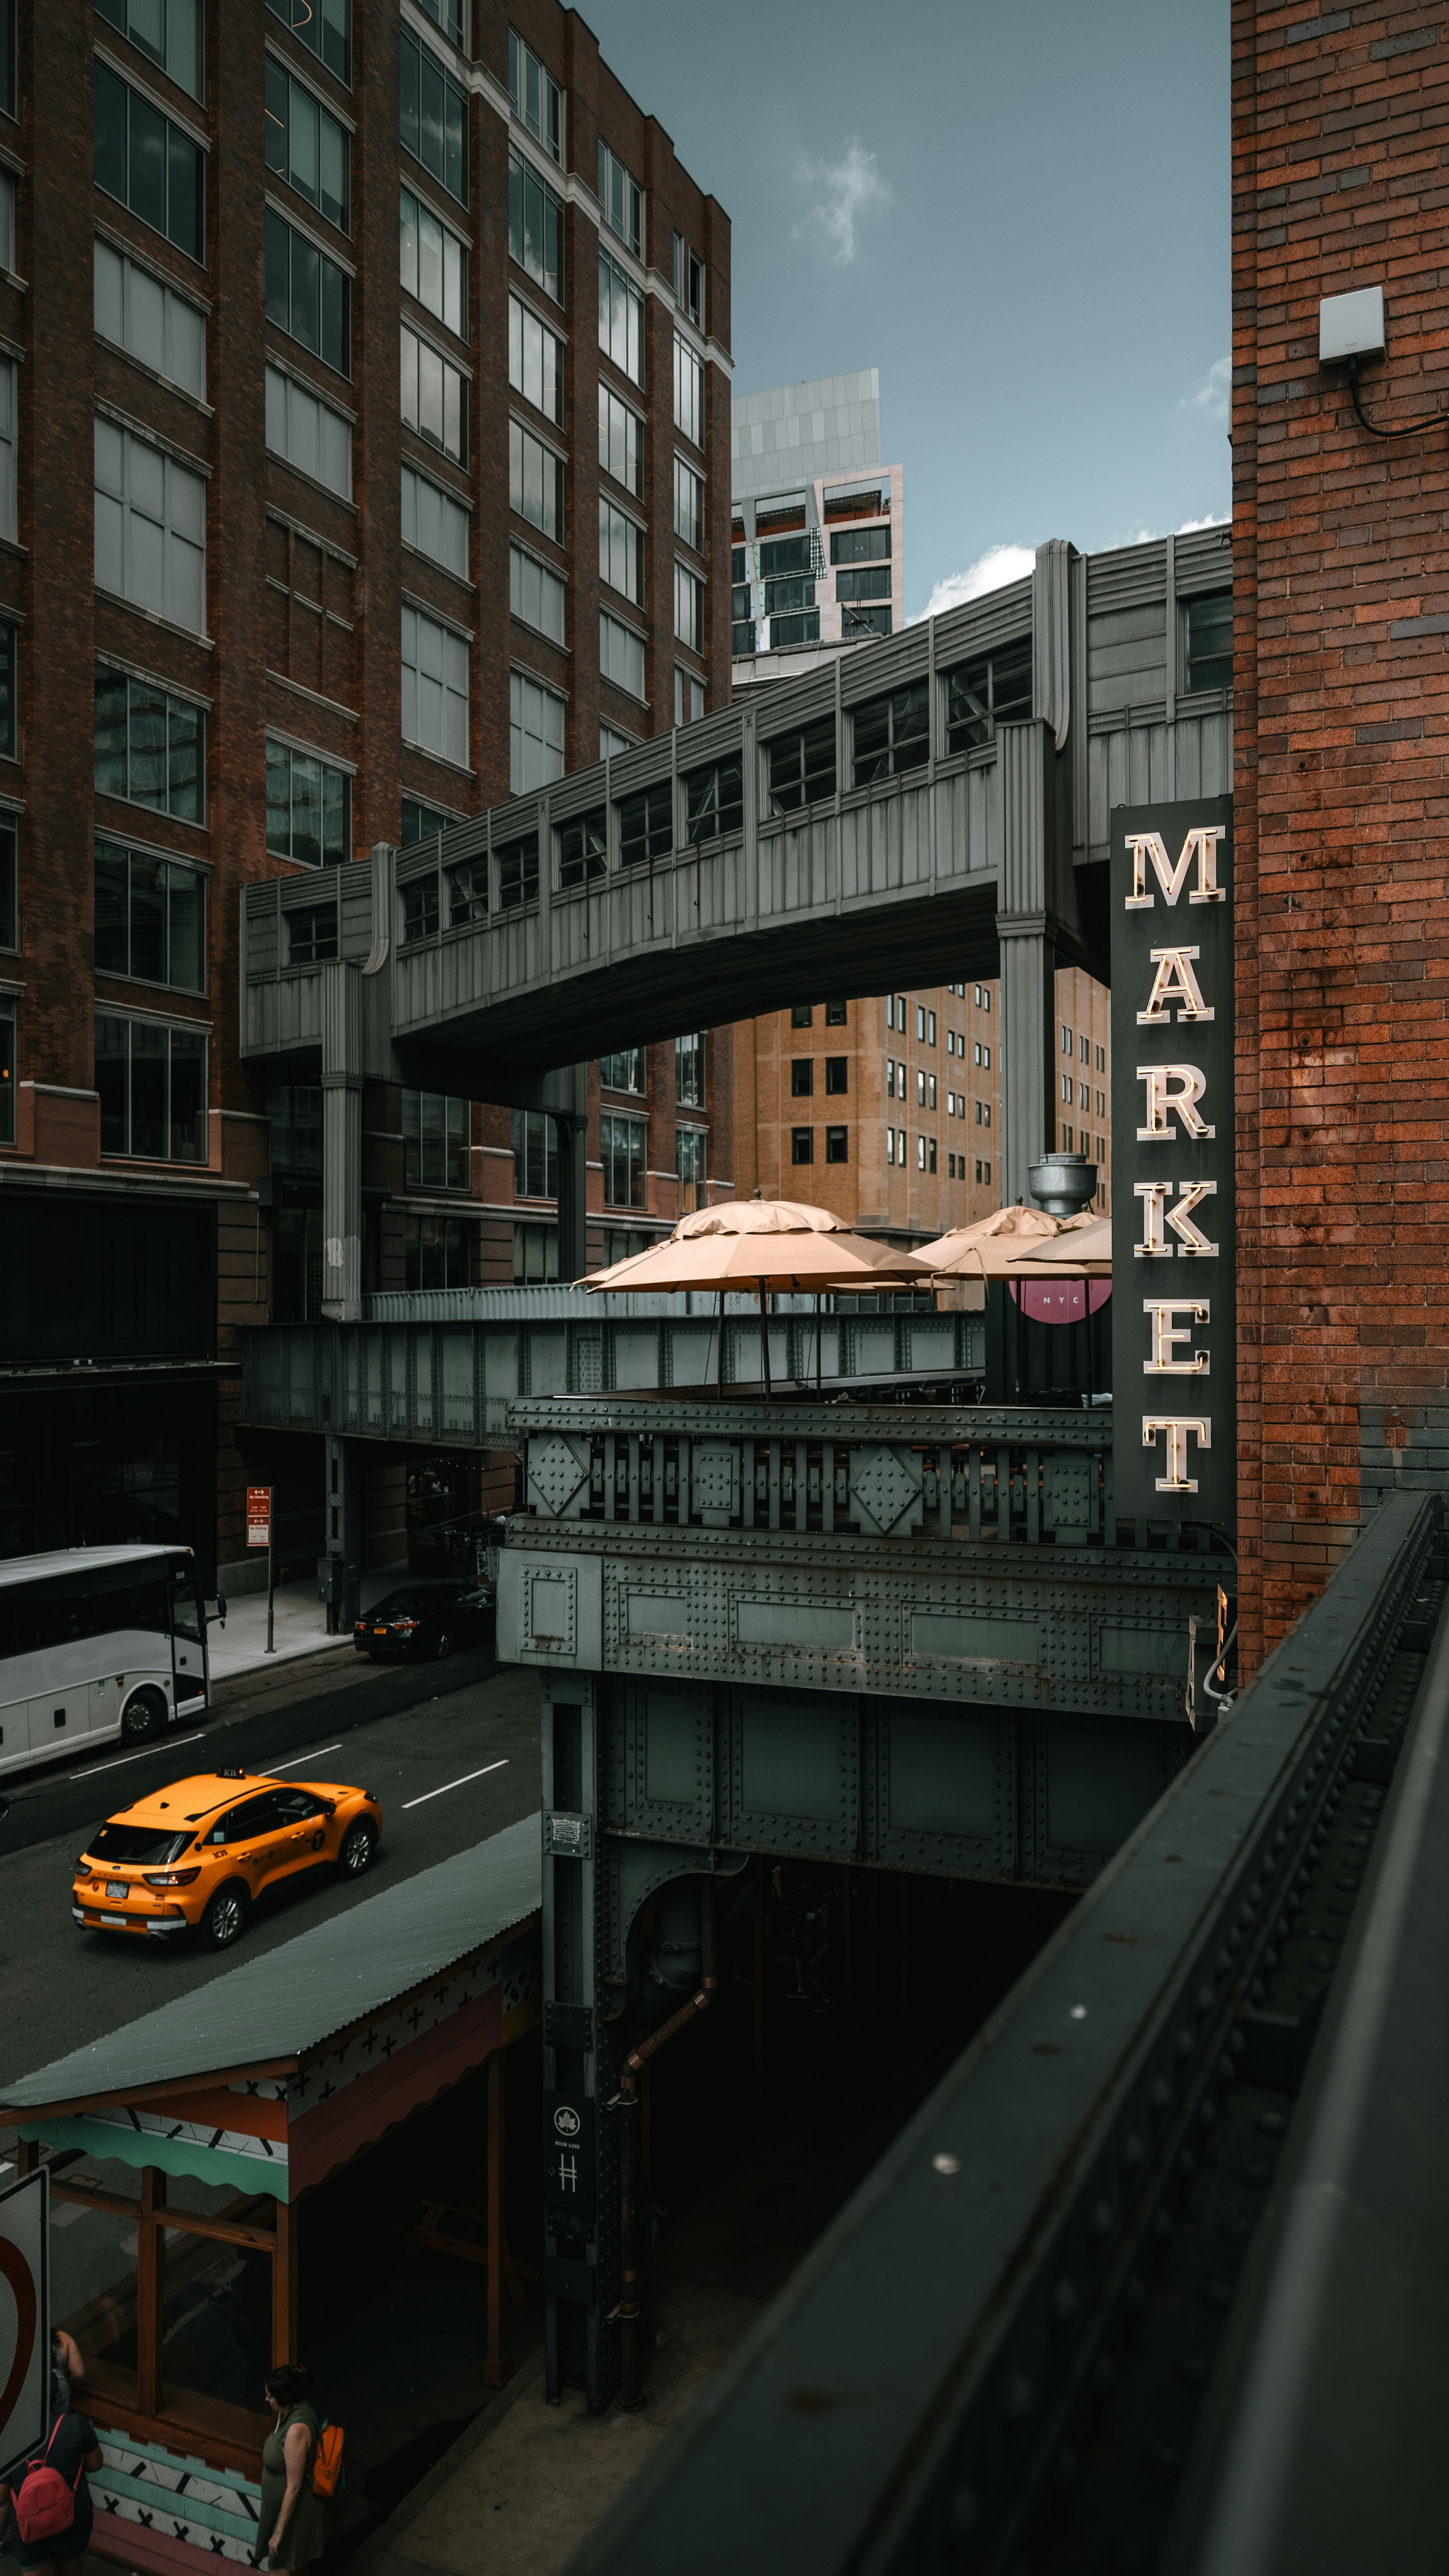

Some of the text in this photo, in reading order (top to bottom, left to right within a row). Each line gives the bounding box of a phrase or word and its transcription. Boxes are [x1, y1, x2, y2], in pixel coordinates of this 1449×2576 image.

[1125, 825, 1226, 1493] MARKET
[223, 1769, 237, 1777] 3C35
[212, 1849, 228, 1859] 3C35
